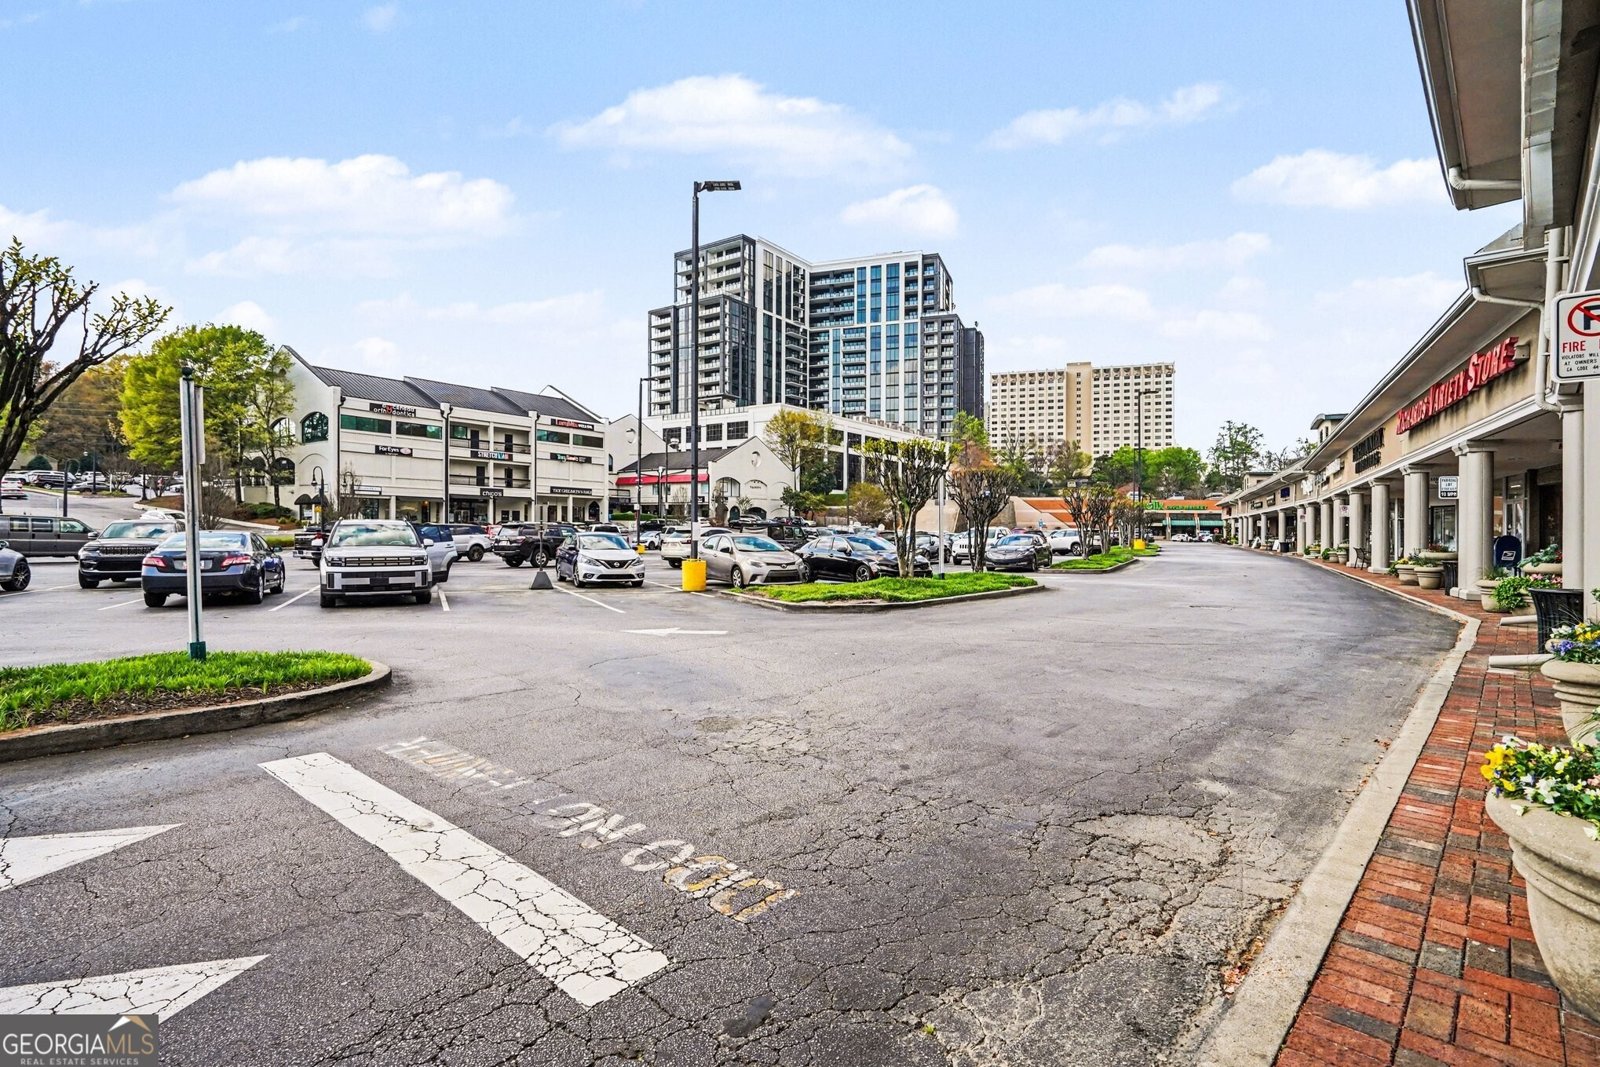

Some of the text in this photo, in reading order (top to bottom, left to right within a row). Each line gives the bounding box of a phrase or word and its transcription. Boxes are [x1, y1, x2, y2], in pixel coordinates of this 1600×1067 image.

[1562, 340, 1586, 353] FIRE
[1427, 370, 1468, 416] VARIETY
[1467, 336, 1519, 391] STORE
